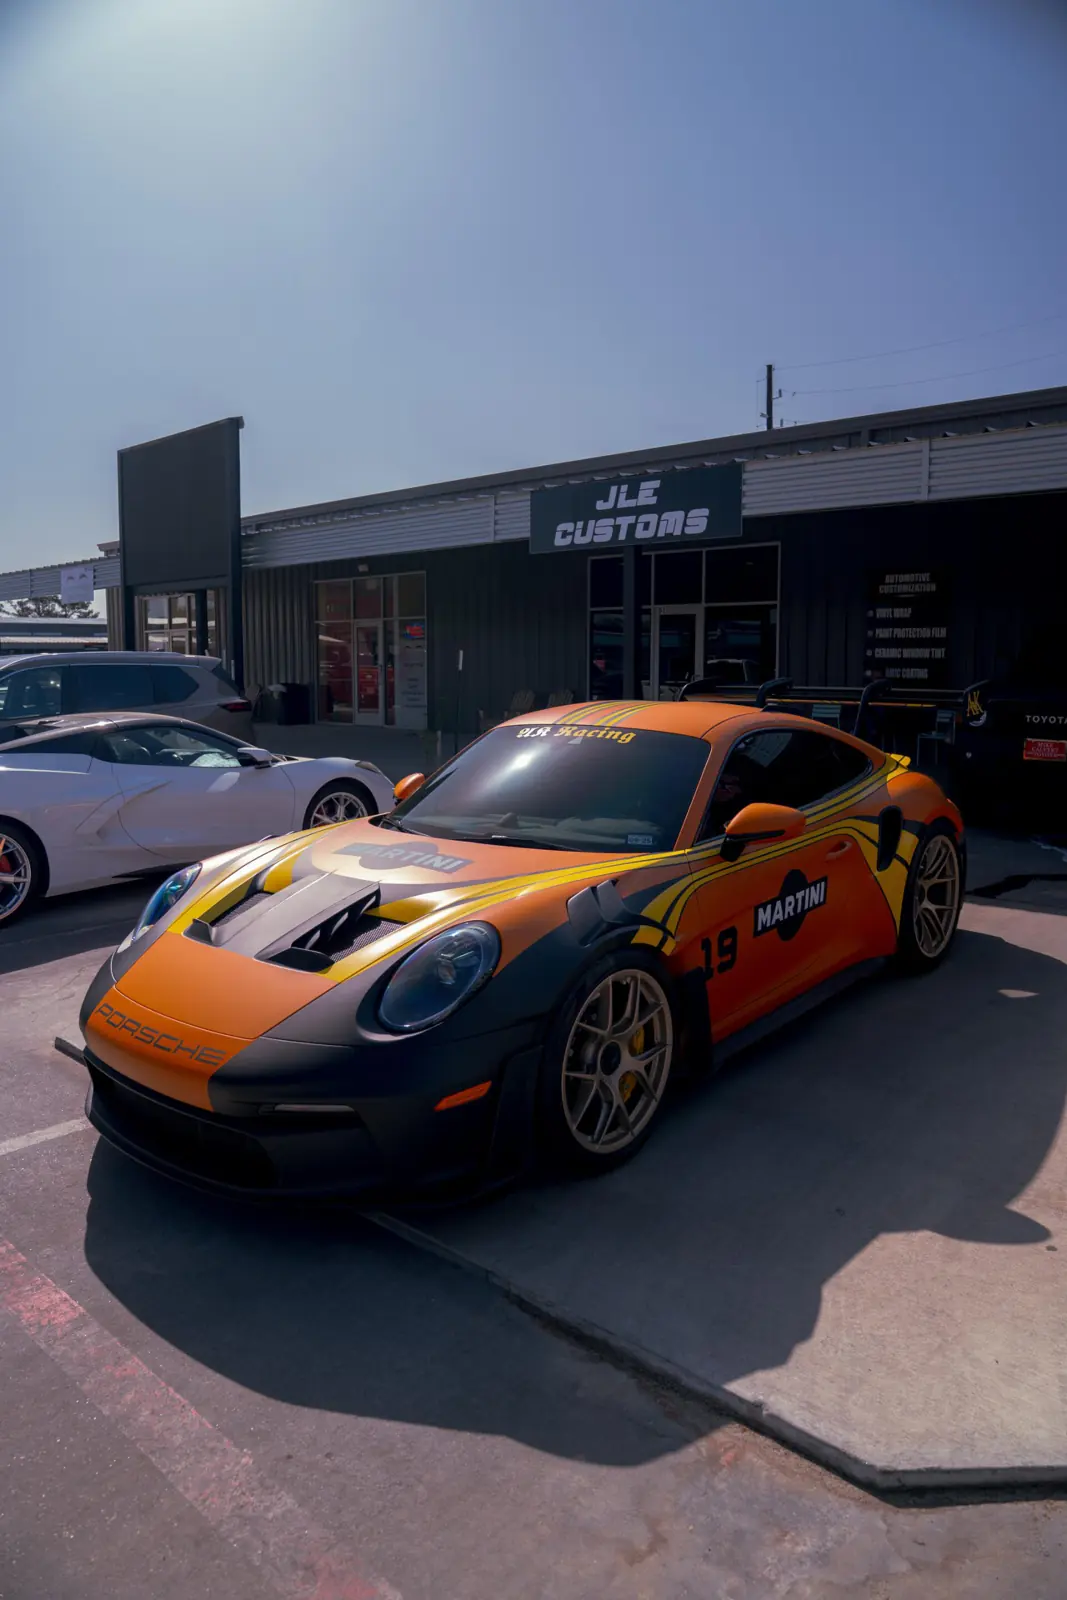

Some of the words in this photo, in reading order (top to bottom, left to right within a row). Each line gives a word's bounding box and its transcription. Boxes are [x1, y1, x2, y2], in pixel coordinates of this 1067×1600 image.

[595, 480, 661, 510] JLE
[554, 508, 710, 547] CUSTOMS
[893, 627, 931, 639] PROTECTION
[931, 627, 947, 638] FILM
[554, 725, 636, 744] Racing
[346, 843, 464, 871] MARTINI
[757, 881, 826, 932] MARTINI
[702, 926, 738, 980] 19
[95, 1003, 228, 1067] PORSCHE
